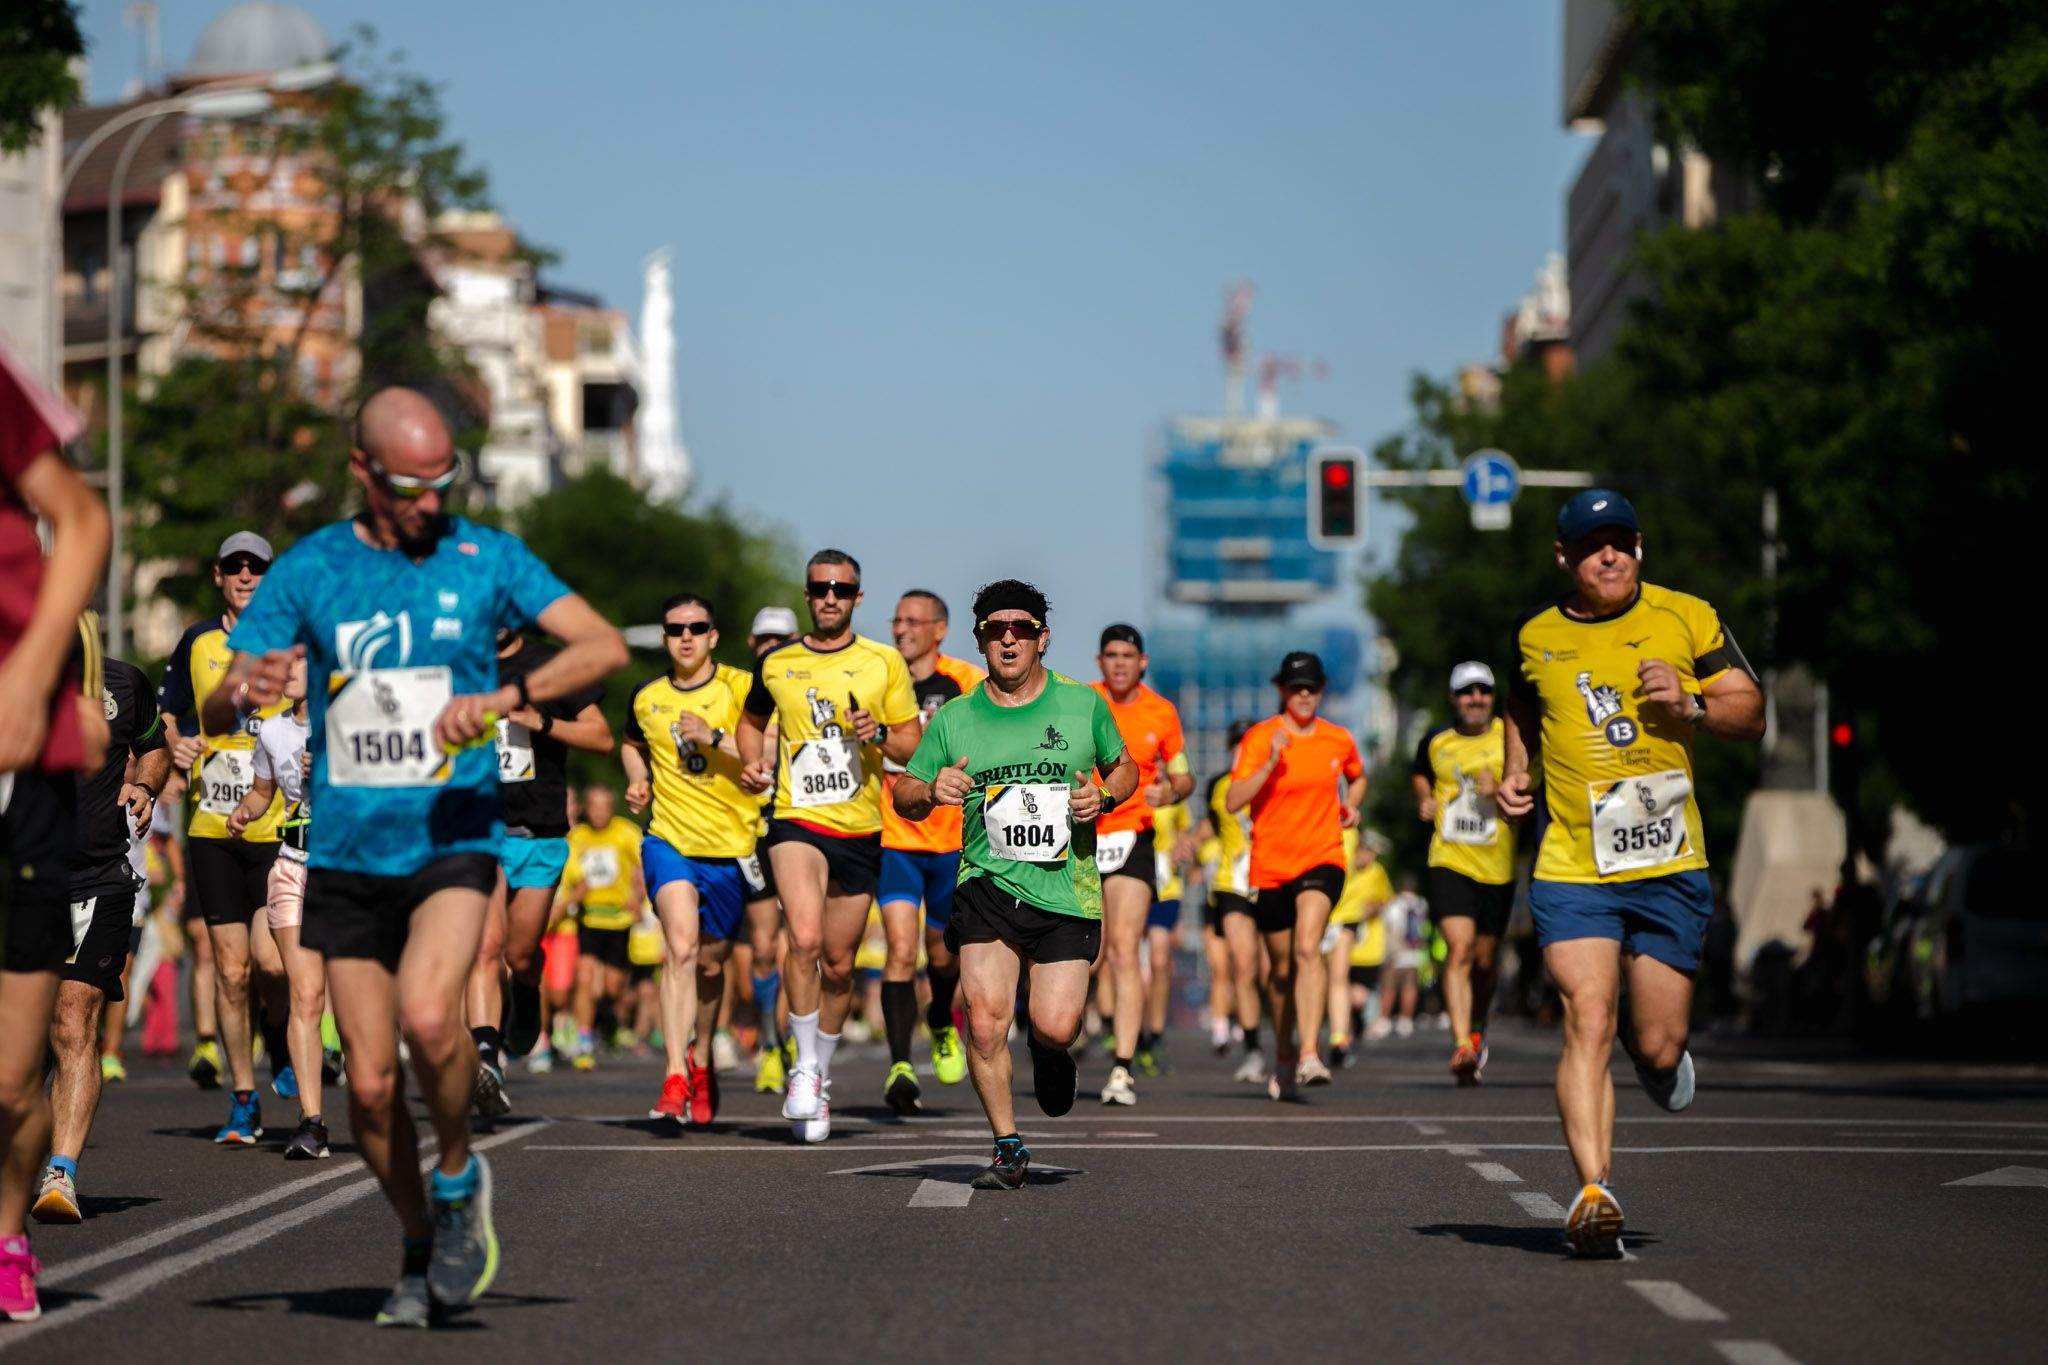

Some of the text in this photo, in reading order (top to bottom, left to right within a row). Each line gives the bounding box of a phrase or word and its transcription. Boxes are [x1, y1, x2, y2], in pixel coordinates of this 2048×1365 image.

[1611, 722, 1633, 741] 13
[351, 730, 425, 765] 1504
[803, 771, 850, 793] 3846
[1002, 824, 1055, 848] 1804
[1612, 817, 1673, 853] 3553
